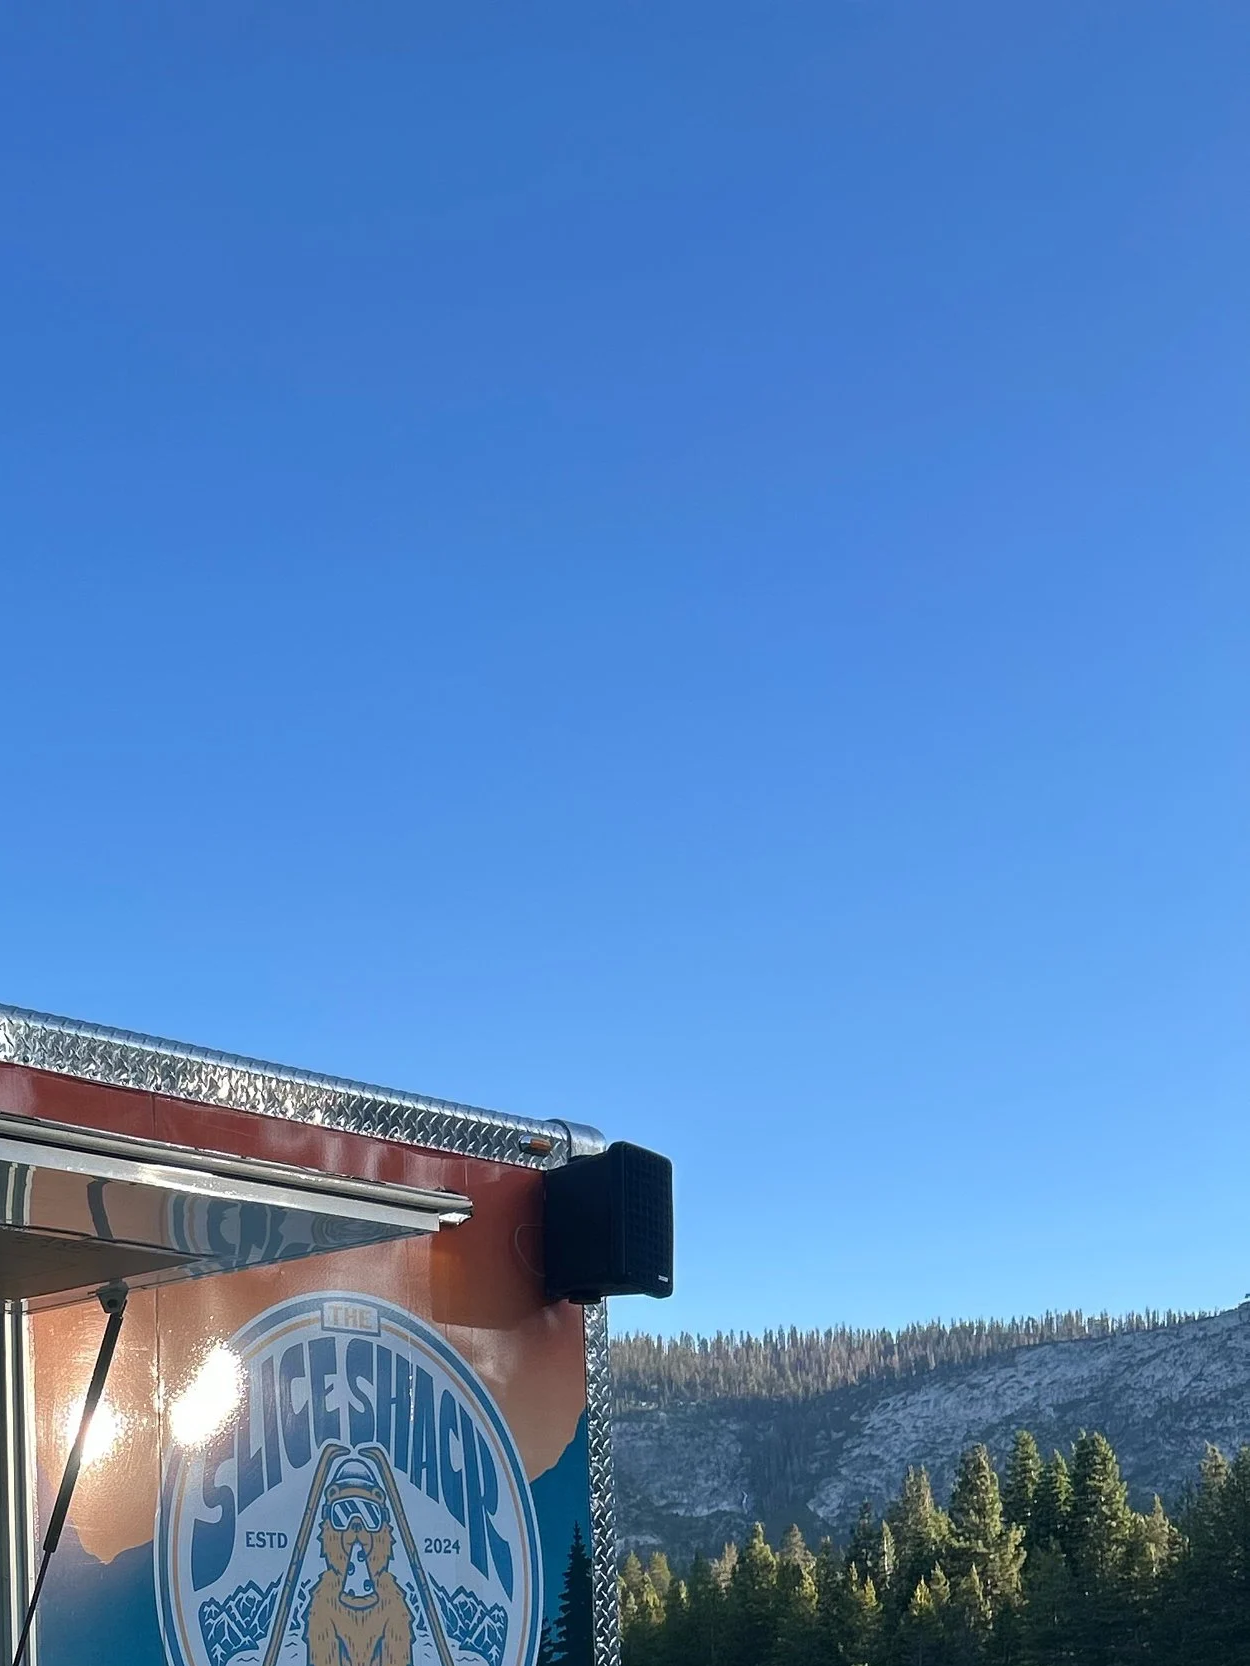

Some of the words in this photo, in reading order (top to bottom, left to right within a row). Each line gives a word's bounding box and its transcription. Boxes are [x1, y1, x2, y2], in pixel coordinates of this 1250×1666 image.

[328, 1305, 373, 1330] THE
[191, 1336, 341, 1592] SLICE
[345, 1337, 513, 1603] SHACK
[245, 1531, 288, 1549] ESTD
[424, 1538, 461, 1554] 2024
